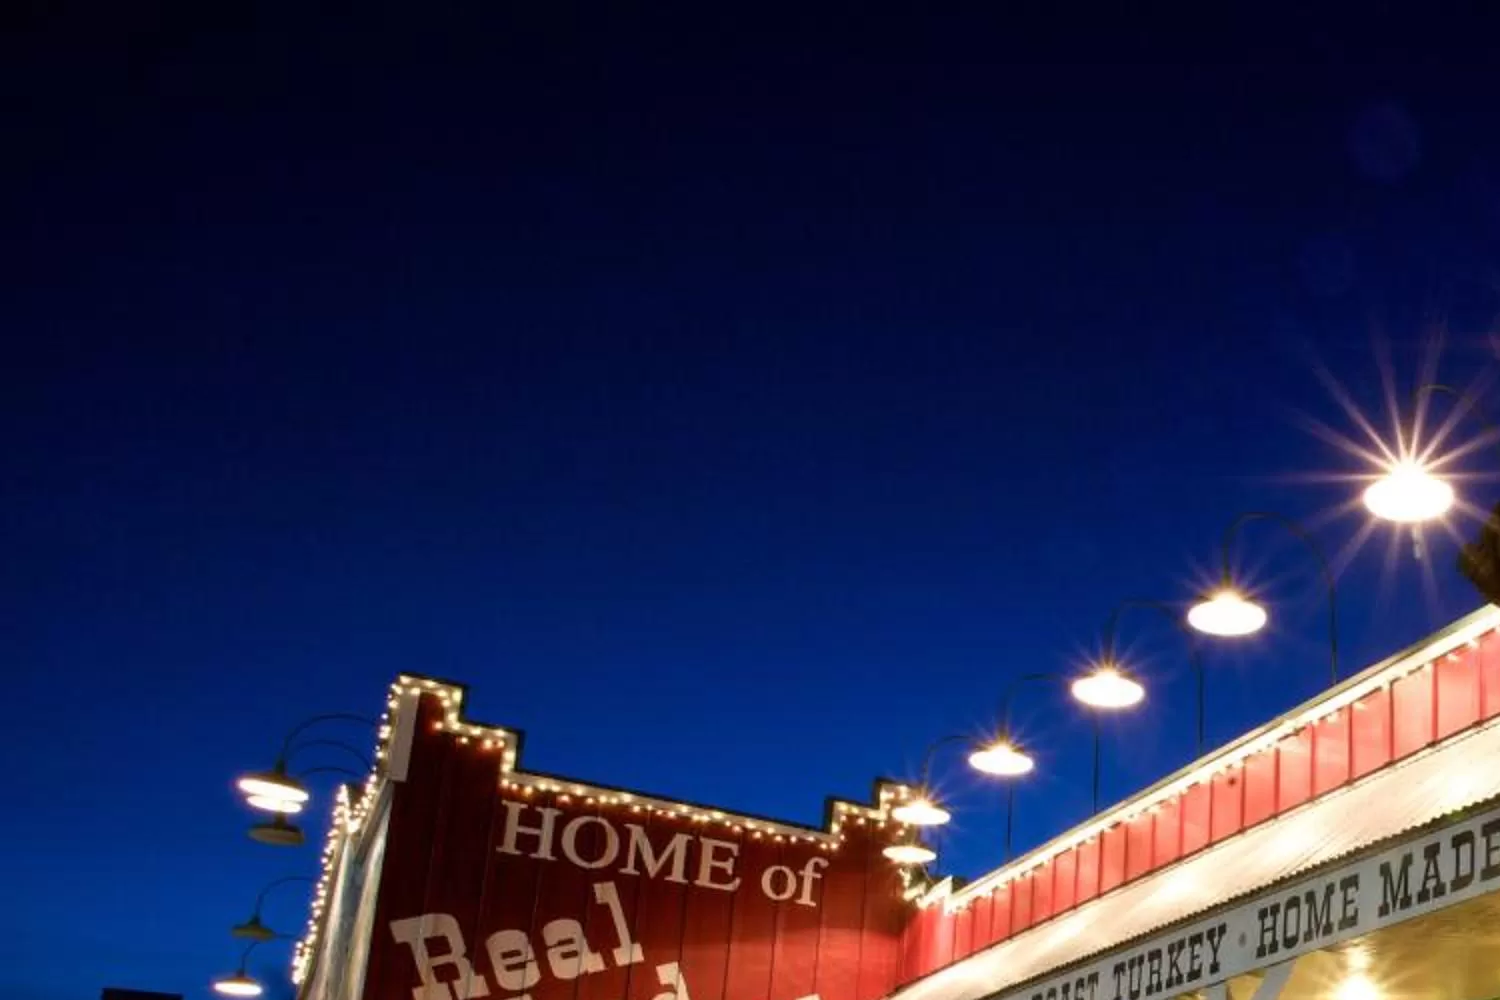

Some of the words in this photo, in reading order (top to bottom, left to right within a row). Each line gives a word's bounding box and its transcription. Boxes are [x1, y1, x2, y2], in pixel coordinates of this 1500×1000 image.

[496, 800, 742, 892] HOME
[760, 856, 829, 908] of
[1255, 873, 1361, 959] HOME
